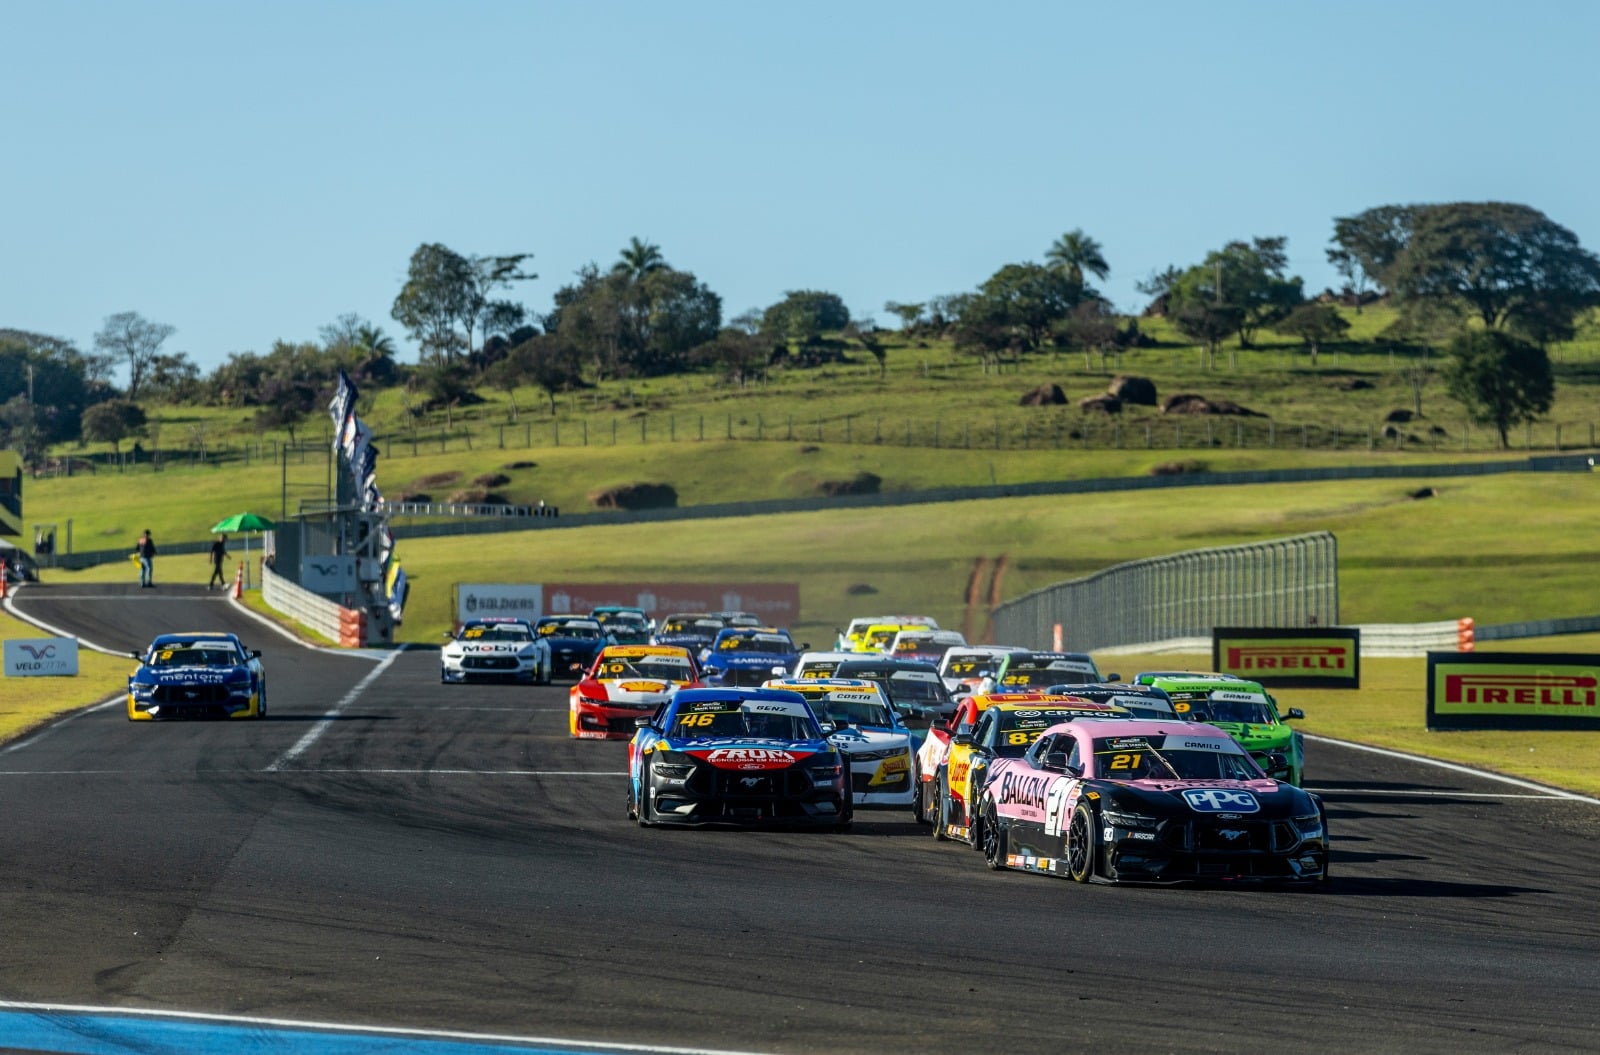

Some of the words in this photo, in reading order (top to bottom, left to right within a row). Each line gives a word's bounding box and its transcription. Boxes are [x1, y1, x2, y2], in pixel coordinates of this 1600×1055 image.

[463, 644, 518, 653] Mobil
[1227, 646, 1346, 670] PIRELLI
[15, 662, 67, 671] VELOCITTA
[160, 673, 223, 682] mentore
[1446, 674, 1597, 706] PIRELLI
[1044, 710, 1121, 718] CRESOL
[680, 713, 715, 727] 46
[1185, 741, 1221, 750] CAMILO
[1110, 755, 1142, 769] 21
[999, 771, 1050, 811] BALLENA
[1190, 790, 1253, 809] PPG
[1132, 832, 1155, 840] NASCAR
